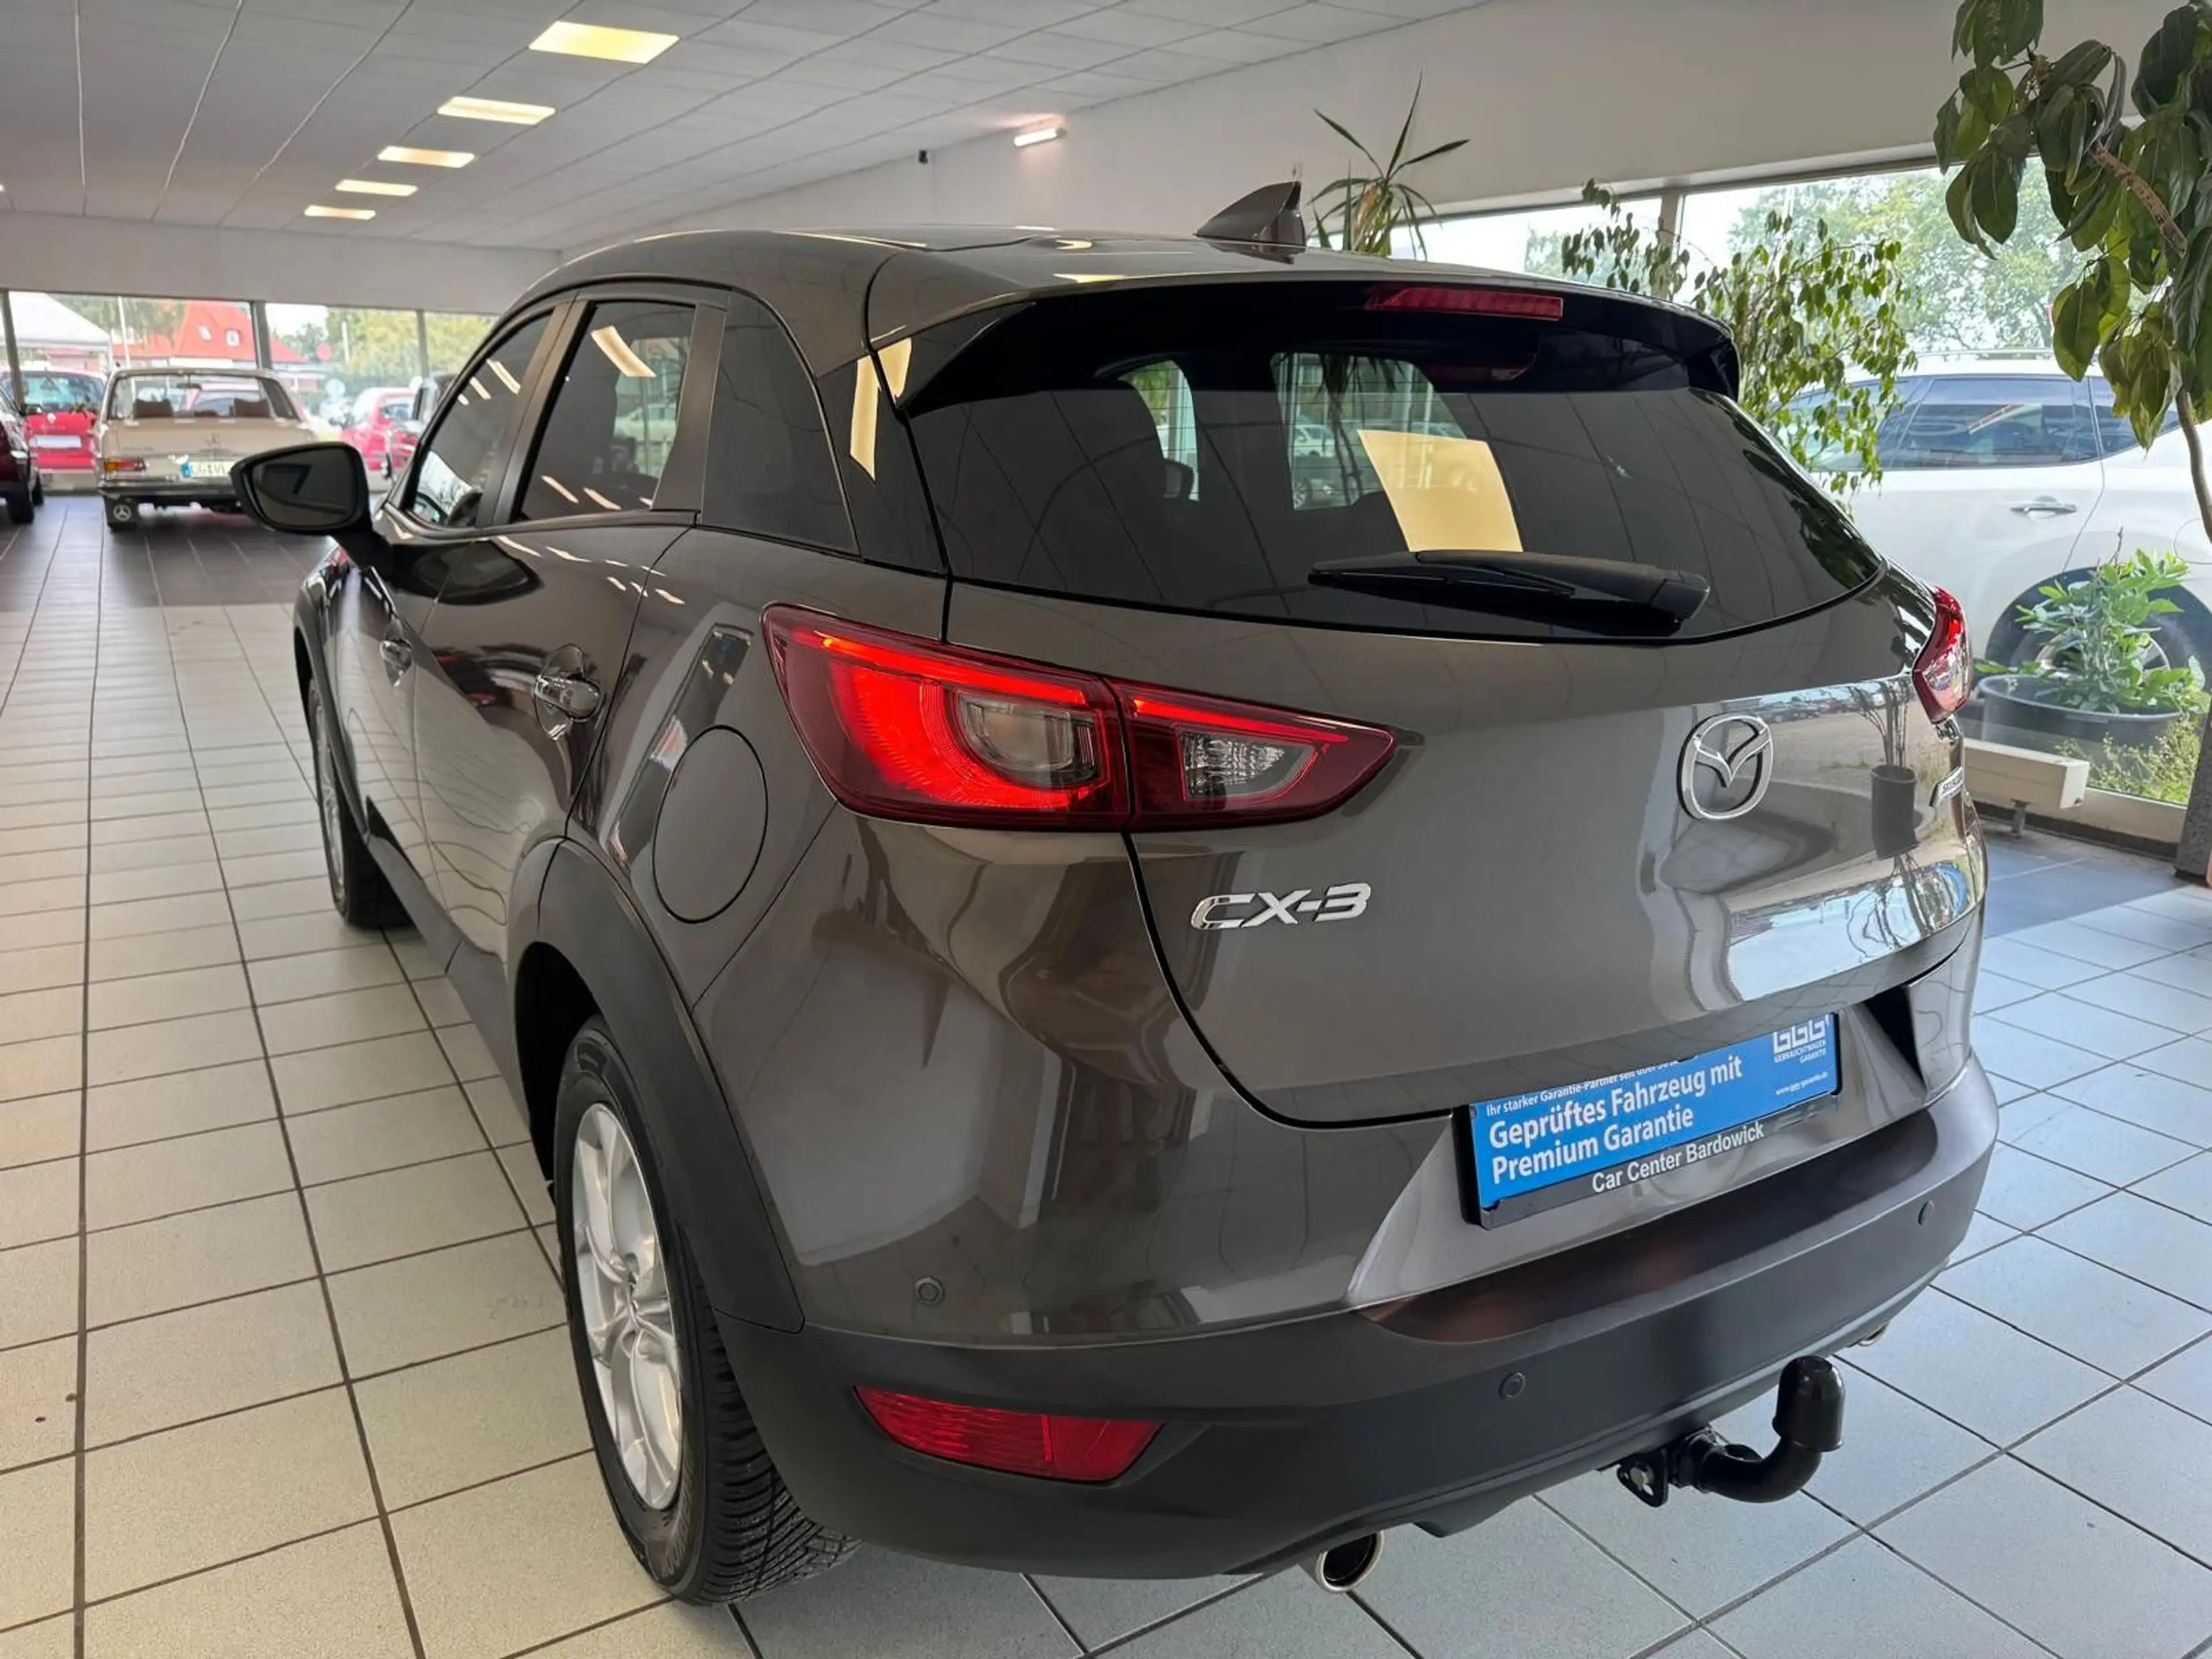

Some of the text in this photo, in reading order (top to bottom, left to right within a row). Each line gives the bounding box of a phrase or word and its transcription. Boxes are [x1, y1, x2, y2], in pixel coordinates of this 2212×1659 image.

[1191, 883, 1371, 930] CX-3
[1486, 1103, 1501, 1117] Ihr
[1503, 1094, 1539, 1113] starker
[1490, 1055, 1742, 1149] Geprüftes Fahrzeug mit
[1493, 1105, 1694, 1184] Premium Garantie
[1592, 1122, 1764, 1194] Car Center Bardowick
